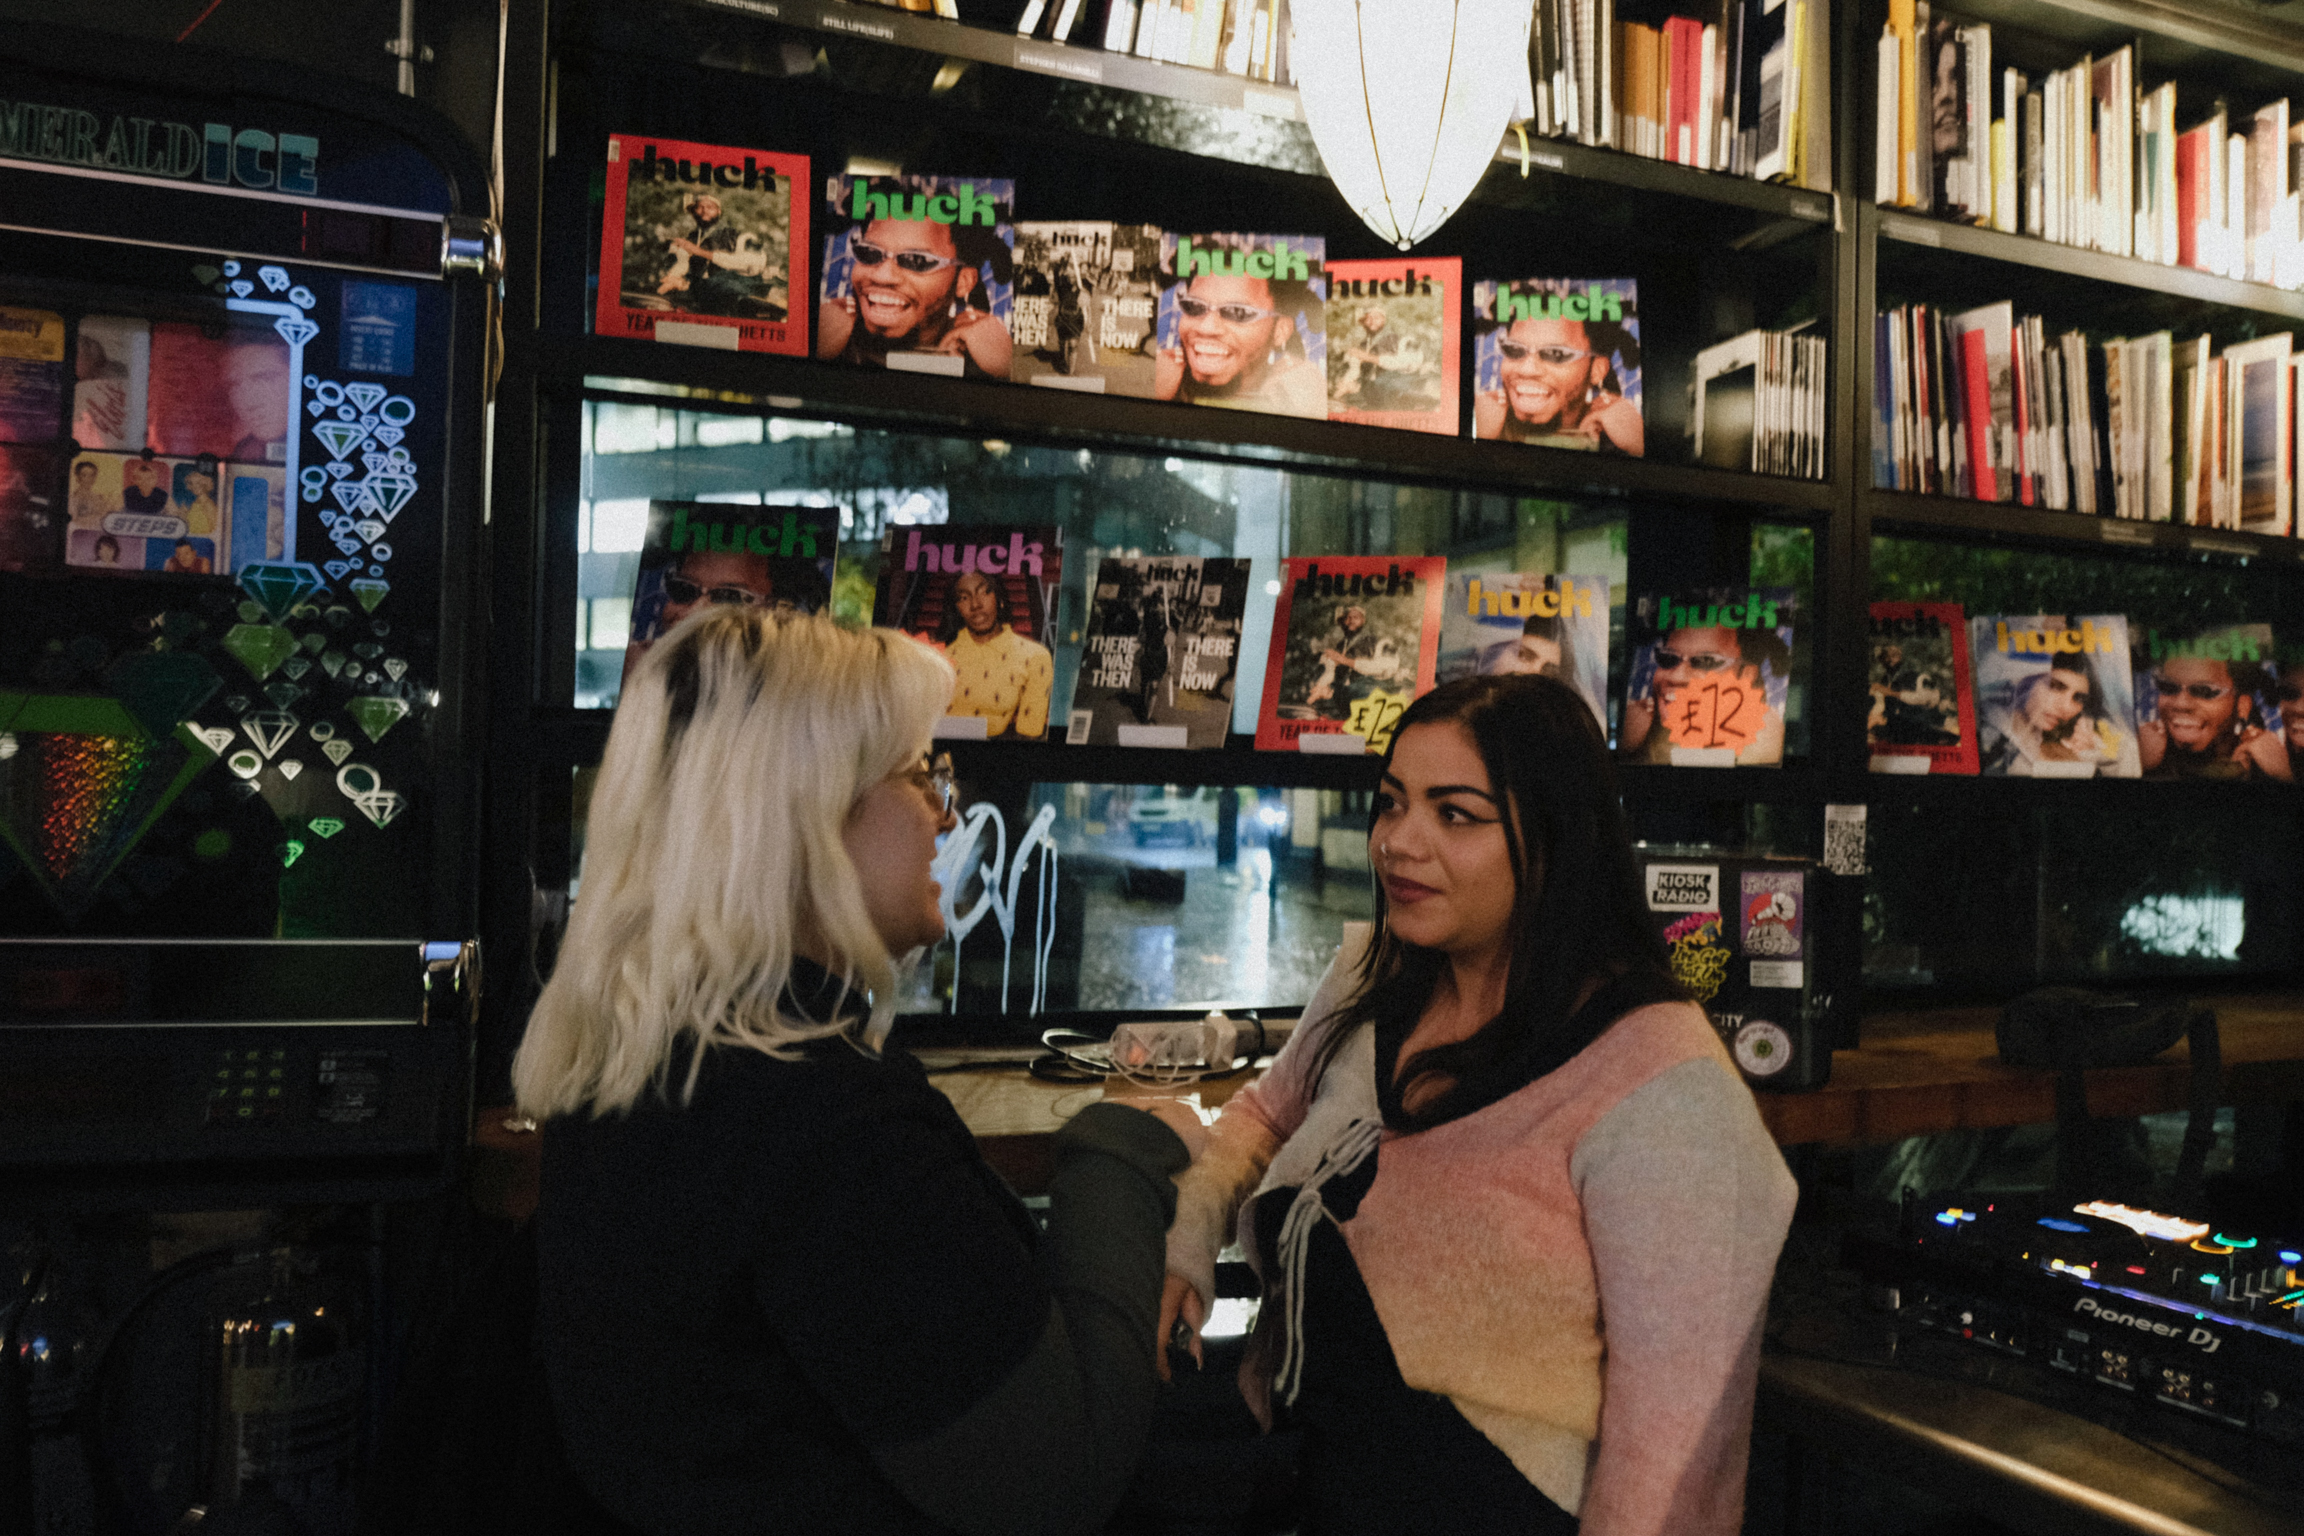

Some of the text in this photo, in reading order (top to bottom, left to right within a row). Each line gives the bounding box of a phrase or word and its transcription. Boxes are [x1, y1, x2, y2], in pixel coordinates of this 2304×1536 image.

[203, 123, 319, 196] ICE
[643, 145, 777, 192] huck
[852, 180, 996, 226] huck
[1177, 236, 1309, 280] huck
[1325, 269, 1431, 299] huck
[1101, 297, 1153, 319] THERE
[1497, 284, 1623, 322] huck
[735, 325, 786, 342] HETTS
[1013, 328, 1048, 346] HEN
[1101, 314, 1117, 333] IS
[1100, 331, 1139, 349] NOW
[110, 517, 182, 535] STEPS
[669, 508, 817, 558] huck
[905, 530, 1044, 575] huck
[1303, 563, 1416, 598] huck
[1467, 579, 1592, 618] huck
[1657, 594, 1779, 629] huck
[1091, 635, 1139, 655] THERE
[1186, 636, 1235, 657] THERE
[1997, 620, 2115, 654] huck
[2148, 629, 2261, 662] huck
[1101, 651, 1134, 671] WAS
[1182, 654, 1198, 674] IS
[1091, 670, 1131, 689] THEN
[1179, 672, 1218, 691] NOW
[1354, 698, 1403, 746] £12
[1681, 683, 1746, 748] £12
[1659, 873, 1707, 888] KIOSK
[1656, 889, 1709, 904] RADIO
[2074, 1297, 2183, 1340] Pioneer
